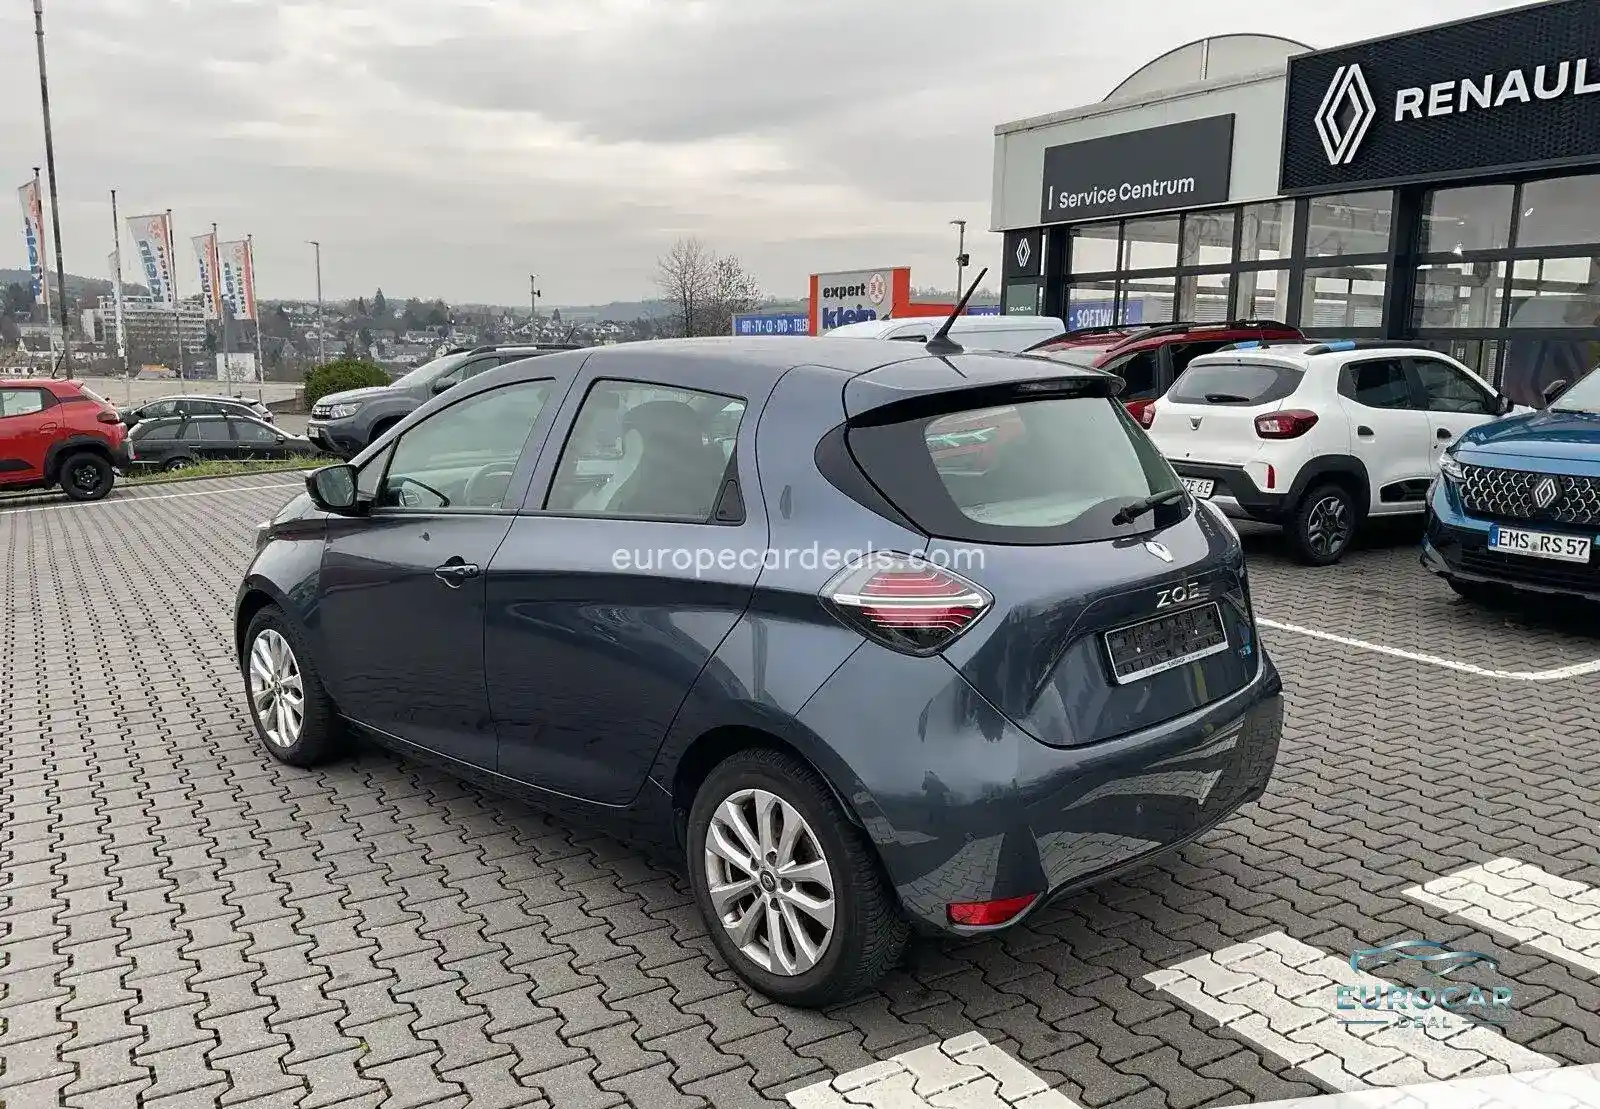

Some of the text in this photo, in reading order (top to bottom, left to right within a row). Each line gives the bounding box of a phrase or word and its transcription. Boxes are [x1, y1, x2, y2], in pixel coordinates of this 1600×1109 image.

[1395, 58, 1600, 122] RENAUL
[1059, 176, 1195, 209] Service Centrum
[823, 283, 866, 300] expert
[755, 319, 762, 332] TV
[766, 319, 773, 333] CD
[777, 319, 788, 333] DVD
[793, 318, 810, 332] TELE
[823, 304, 877, 330] klein
[1077, 308, 1130, 327] SOFTWR
[1499, 530, 1588, 556] EMS RS 57
[1156, 581, 1200, 608] ZOE
